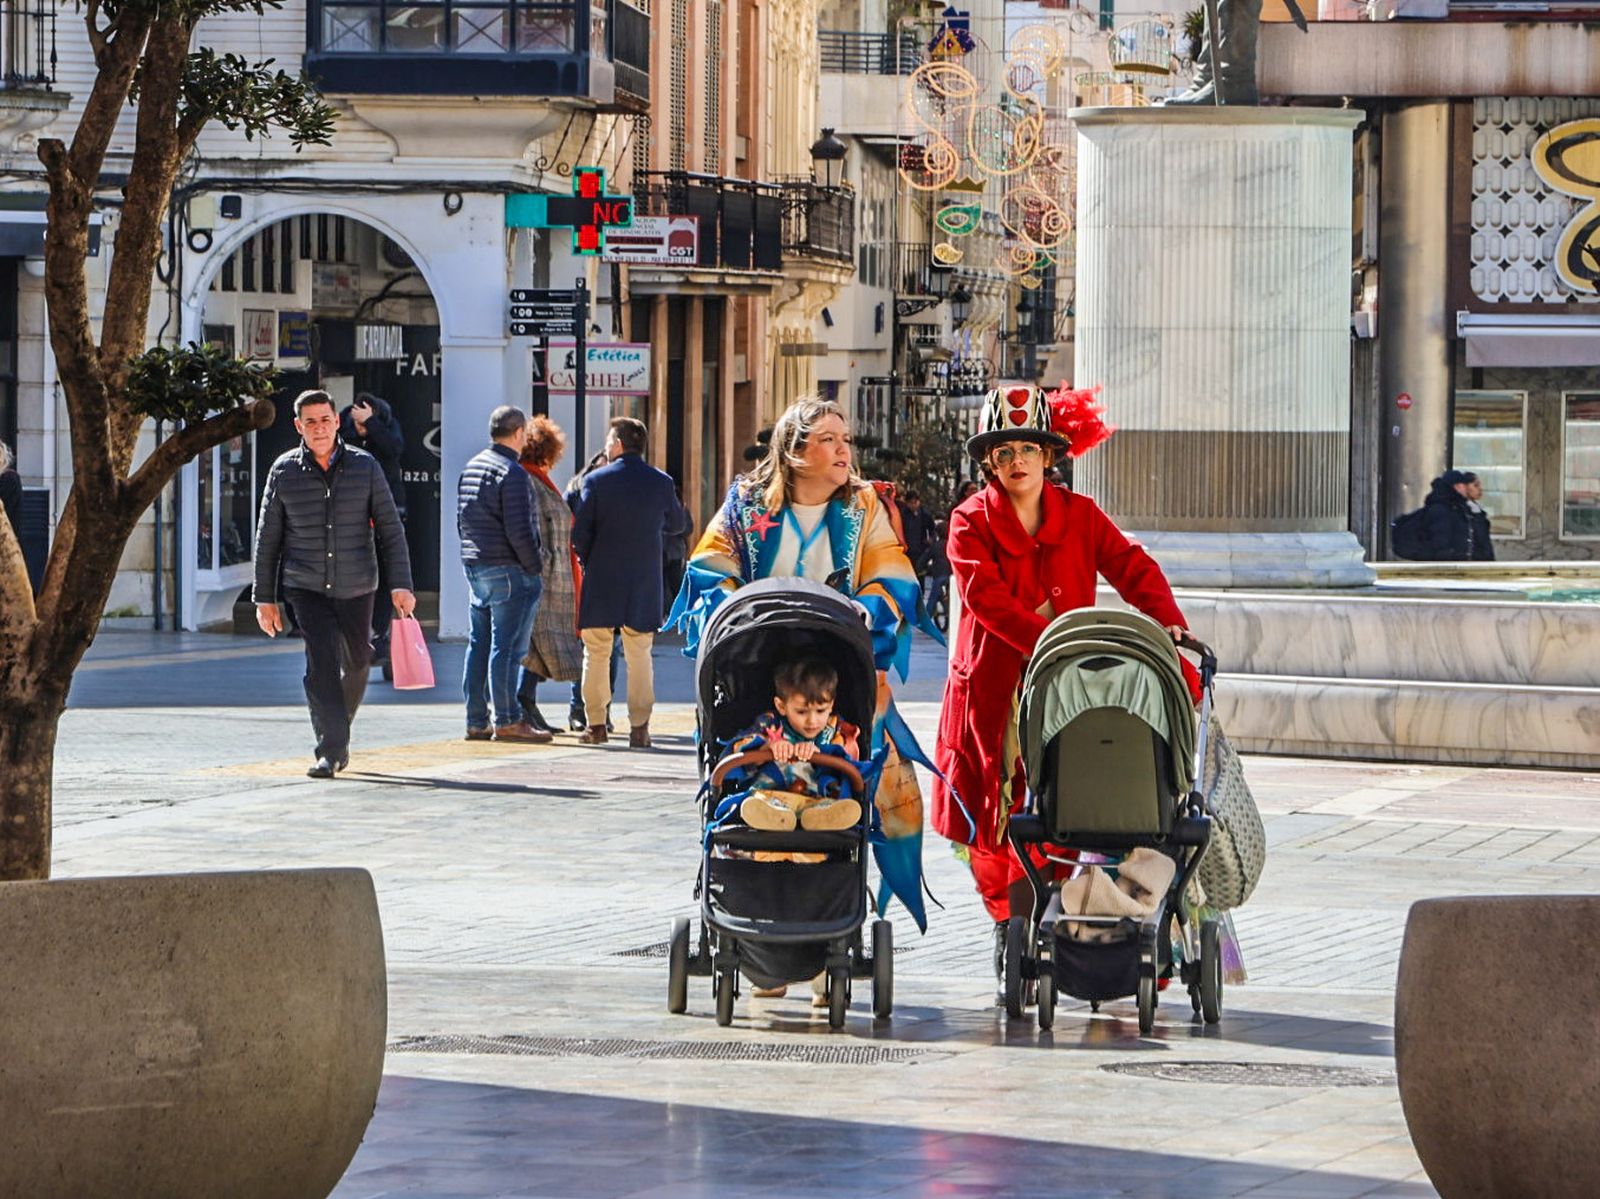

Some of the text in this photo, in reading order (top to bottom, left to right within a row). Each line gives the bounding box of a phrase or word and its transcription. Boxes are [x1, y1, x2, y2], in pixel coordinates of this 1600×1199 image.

[669, 246, 693, 256] CGT
[587, 348, 640, 361] Estética
[396, 353, 442, 376] FAR
[400, 468, 429, 482] laza
